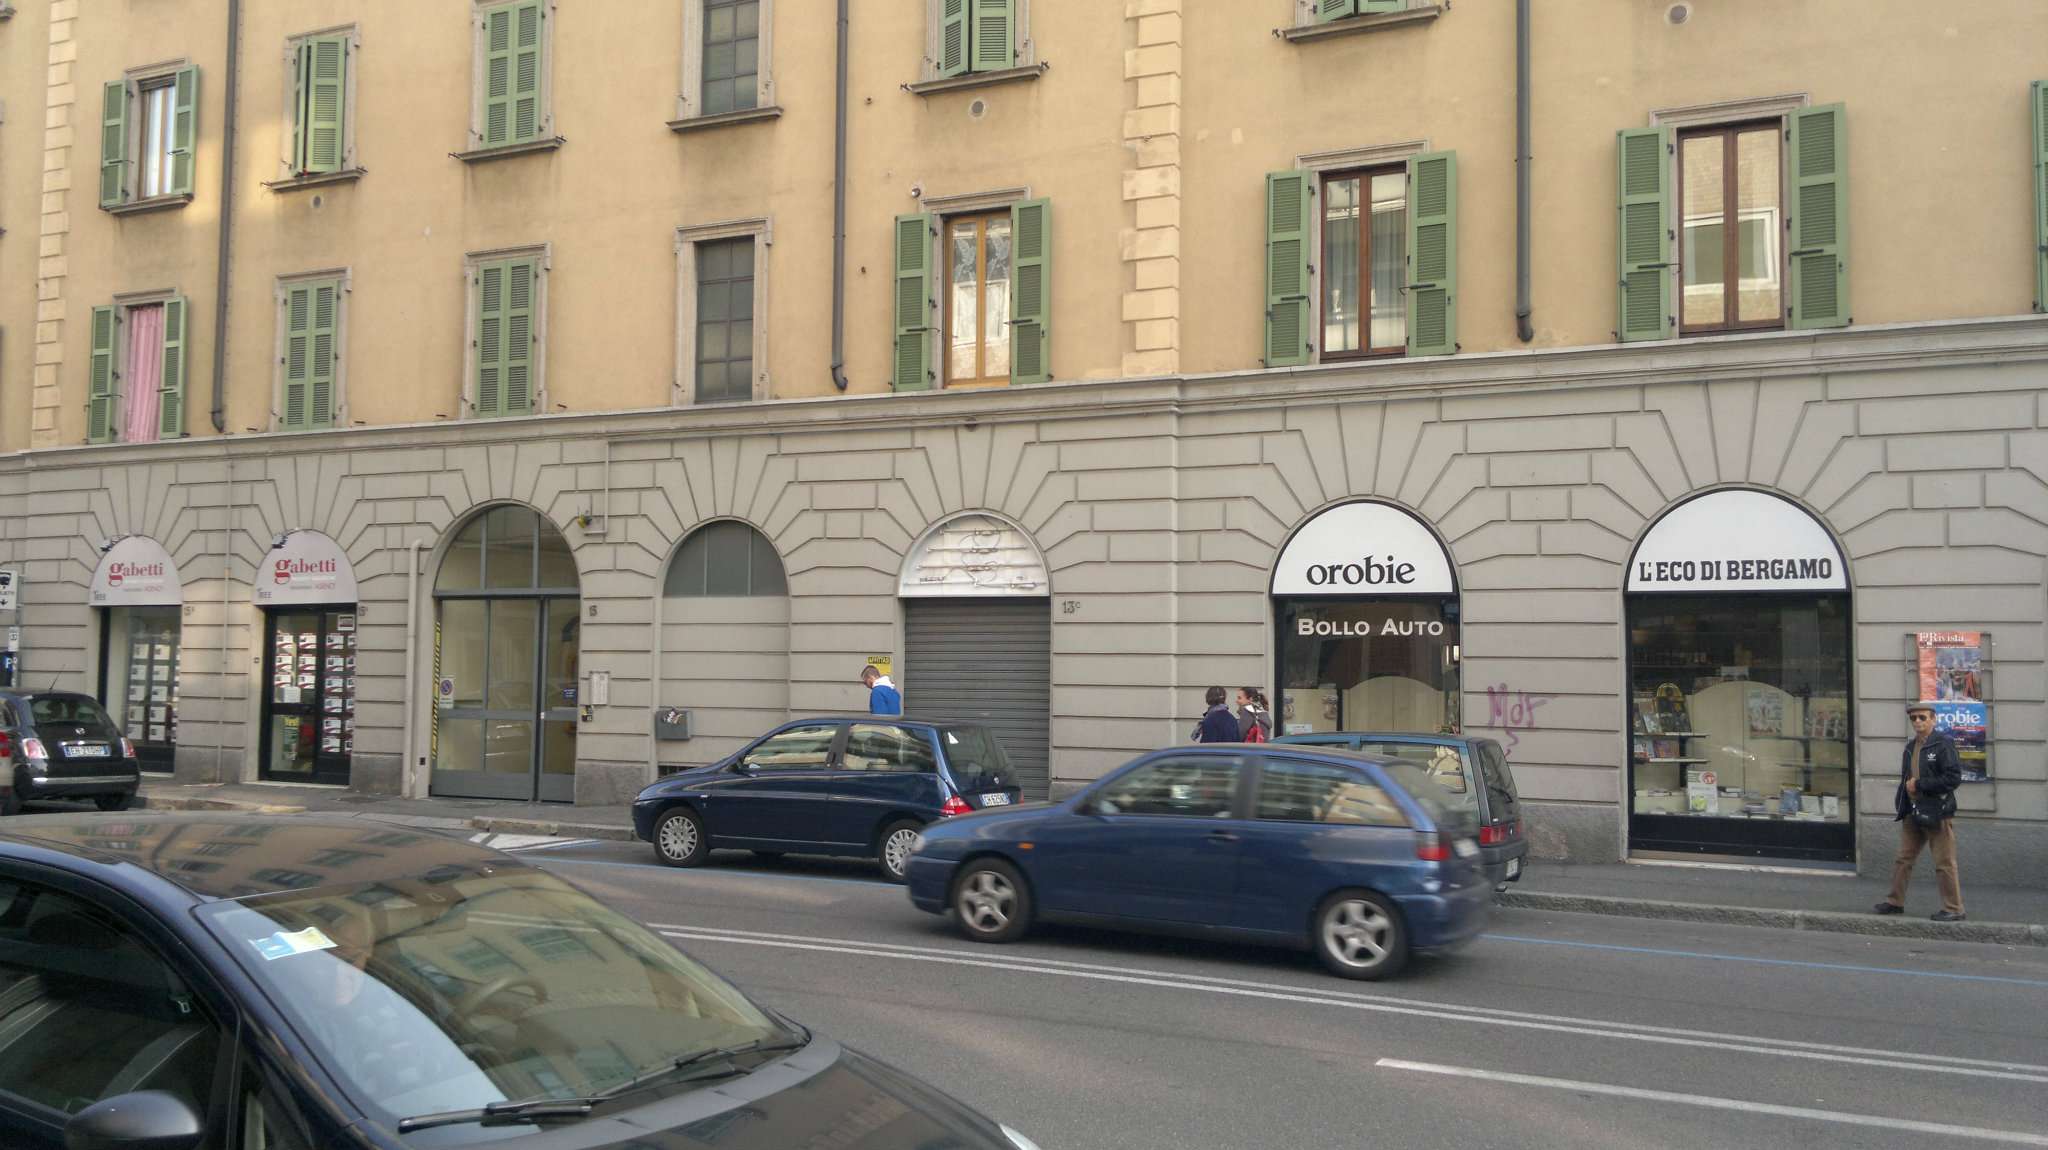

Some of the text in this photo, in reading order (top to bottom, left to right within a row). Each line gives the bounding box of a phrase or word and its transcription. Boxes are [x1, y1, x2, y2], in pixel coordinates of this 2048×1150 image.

[108, 562, 164, 587] gabetti
[274, 558, 337, 585] gabetti
[1306, 555, 1416, 586] orobie
[1639, 557, 1833, 582] L'ECO DI BERGAMO
[1935, 710, 1981, 724] robie
